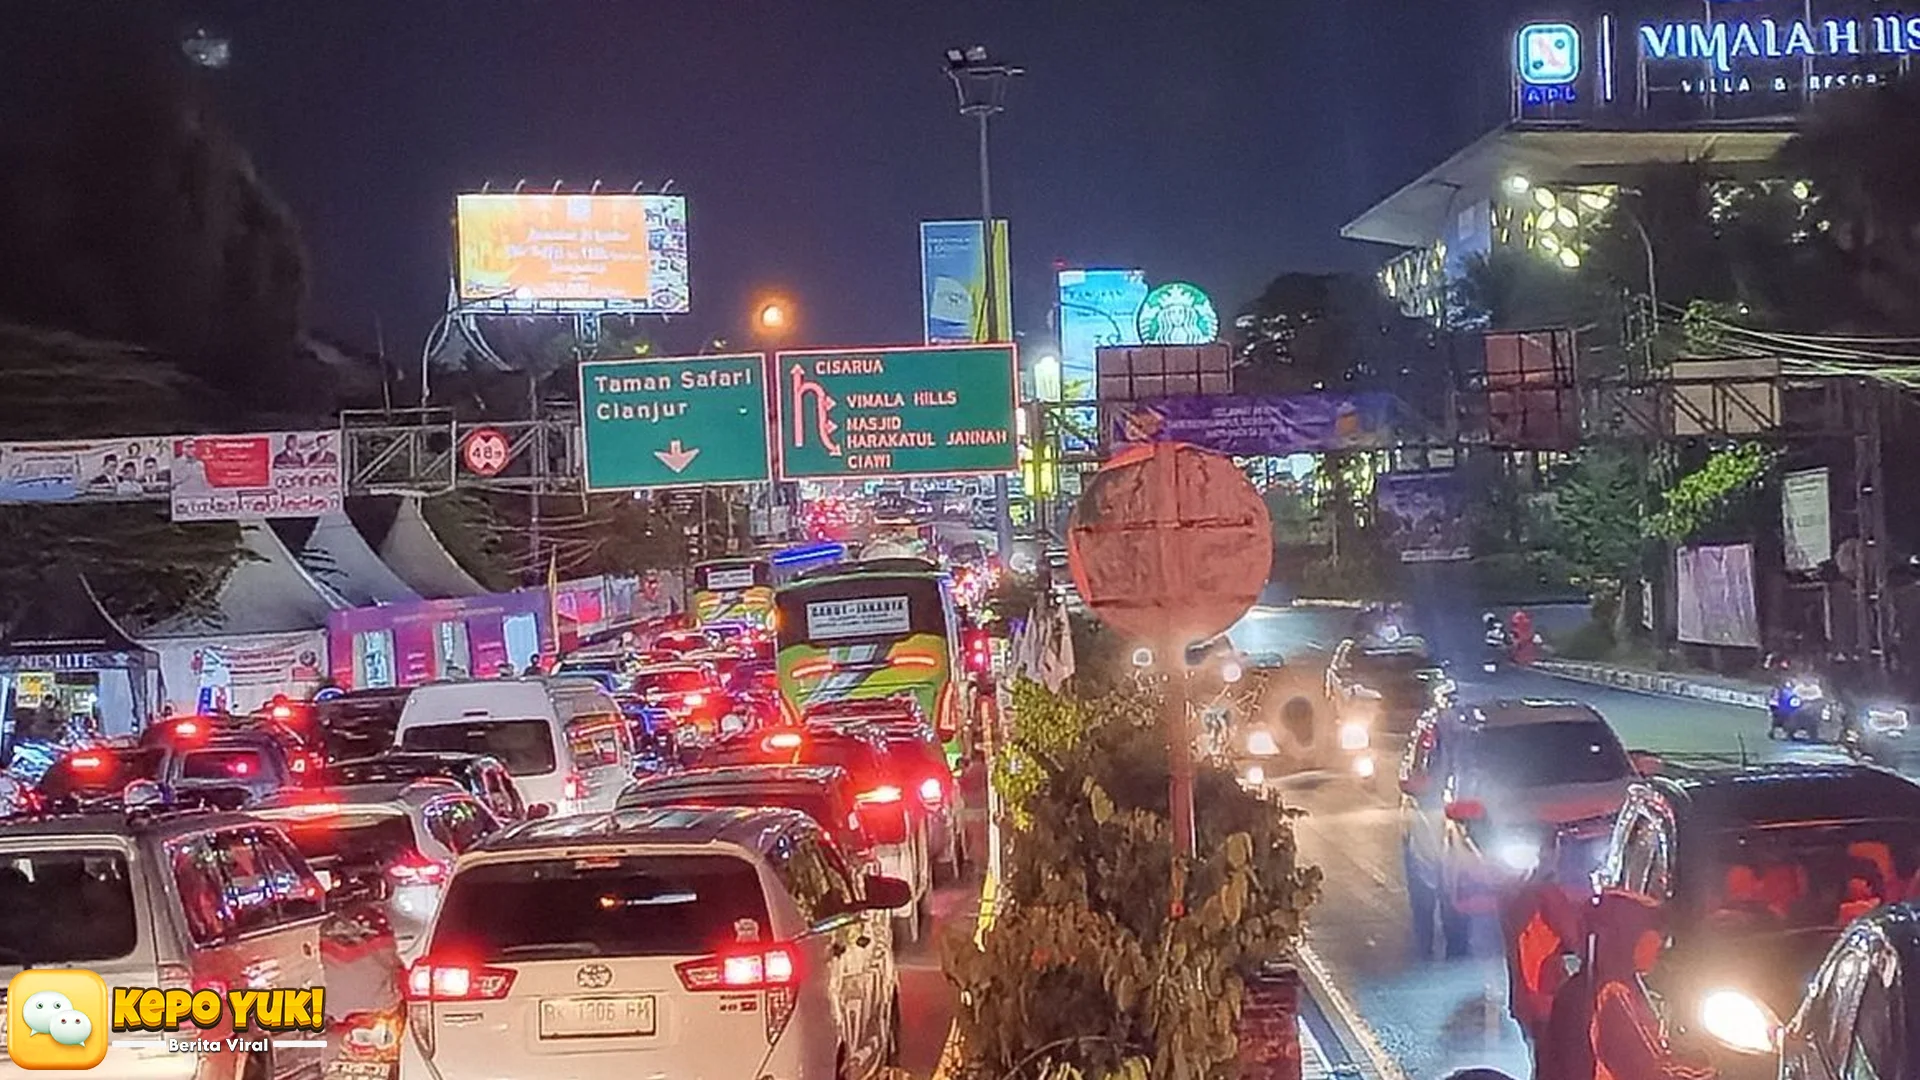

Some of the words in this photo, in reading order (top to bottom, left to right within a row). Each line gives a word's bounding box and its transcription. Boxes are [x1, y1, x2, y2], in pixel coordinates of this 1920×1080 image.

[1640, 20, 1815, 72] VIMALA
[1824, 15, 1920, 54] HLLS
[1681, 78, 1751, 93] VILLA
[1774, 77, 1787, 92] &
[815, 360, 884, 375] CISARUA
[594, 376, 671, 393] Taman
[680, 369, 752, 389] Safari
[846, 393, 905, 409] VIMALA
[914, 391, 957, 406] HILLS
[596, 402, 688, 423] Cianjur
[846, 417, 902, 431] MASJID
[846, 433, 936, 449] HARAKATUL
[946, 430, 1007, 446] JANNAH
[847, 454, 891, 470] CIAWI
